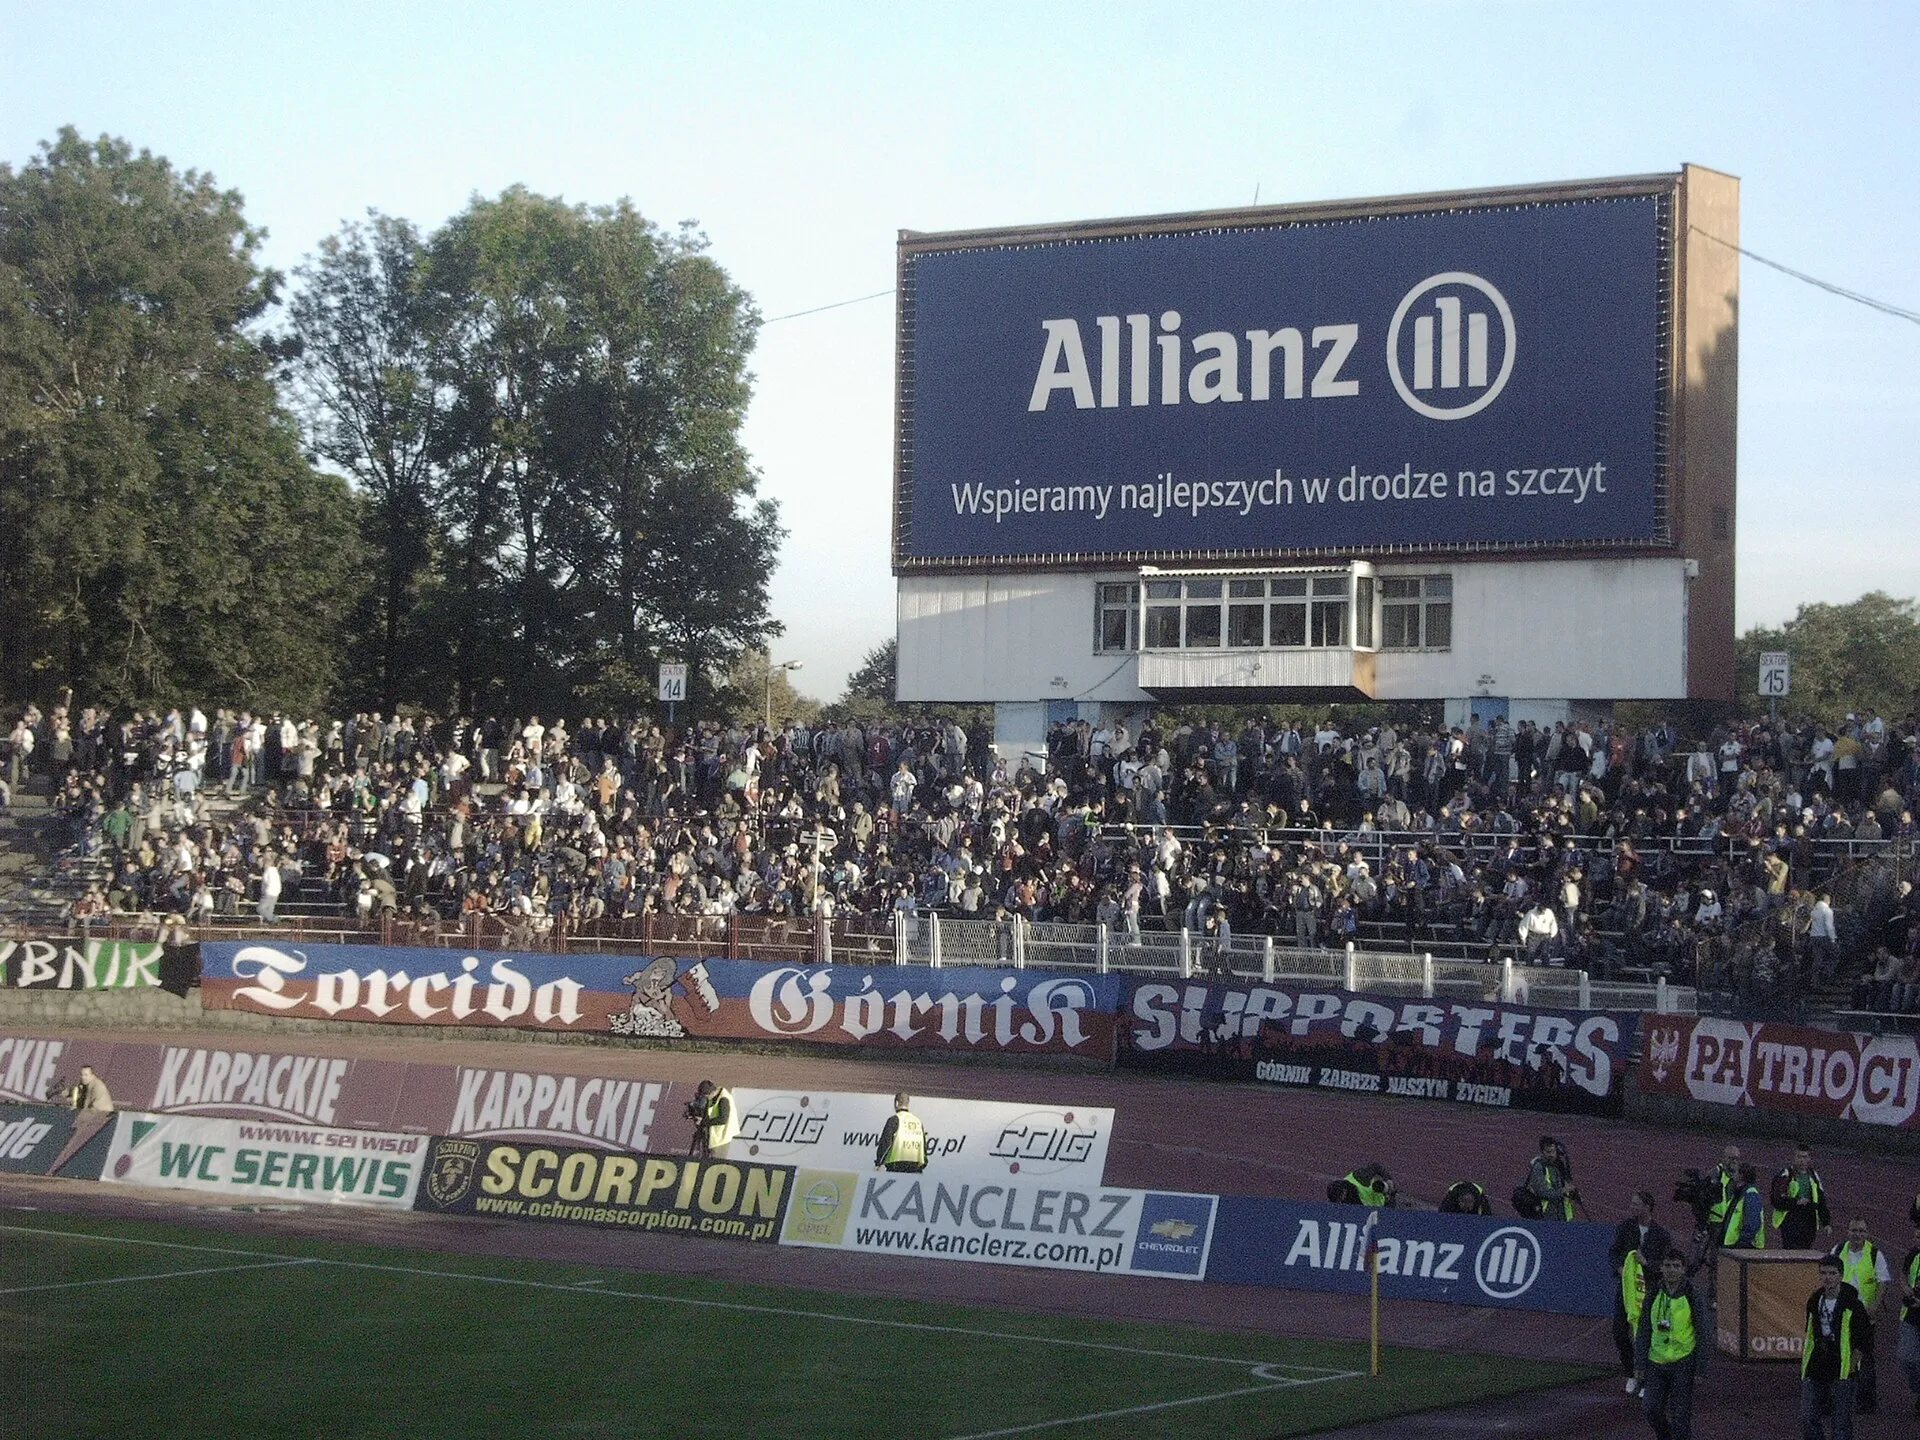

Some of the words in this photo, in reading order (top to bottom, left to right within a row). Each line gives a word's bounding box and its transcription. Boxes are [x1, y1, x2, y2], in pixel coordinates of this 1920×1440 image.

[1027, 310, 1359, 412] Allianz
[951, 479, 1113, 523] Wspieramy
[1120, 469, 1293, 518] najlepszych
[1301, 478, 1331, 504] w
[1338, 463, 1448, 502] drodze
[1457, 470, 1495, 498] na
[1505, 462, 1606, 504] szczyt
[663, 679, 681, 699] 14
[1764, 669, 1785, 693] 15
[232, 946, 585, 1025] Torcida
[1133, 984, 1619, 1096] SUPPORTERS
[152, 1047, 348, 1125] KARPACKIE
[1256, 1059, 1312, 1084] GÓRNIK
[1319, 1067, 1381, 1092] ZABRZE
[1386, 1075, 1448, 1098] NASZYM
[1456, 1078, 1512, 1107] ŻYCIEM
[1690, 1034, 1913, 1108] PATRIOCI
[450, 1066, 663, 1154] KARPACKIE
[159, 1142, 227, 1182] WC
[231, 1148, 412, 1199] SERWIS
[481, 1146, 787, 1219] SCORPION
[475, 1197, 775, 1241] www.ochronascorpion.com.pl
[859, 1177, 1132, 1239] KANCLERZ
[856, 1227, 1123, 1271] www.kanclerz.com.pl
[1139, 1241, 1199, 1254] CHEVROLET
